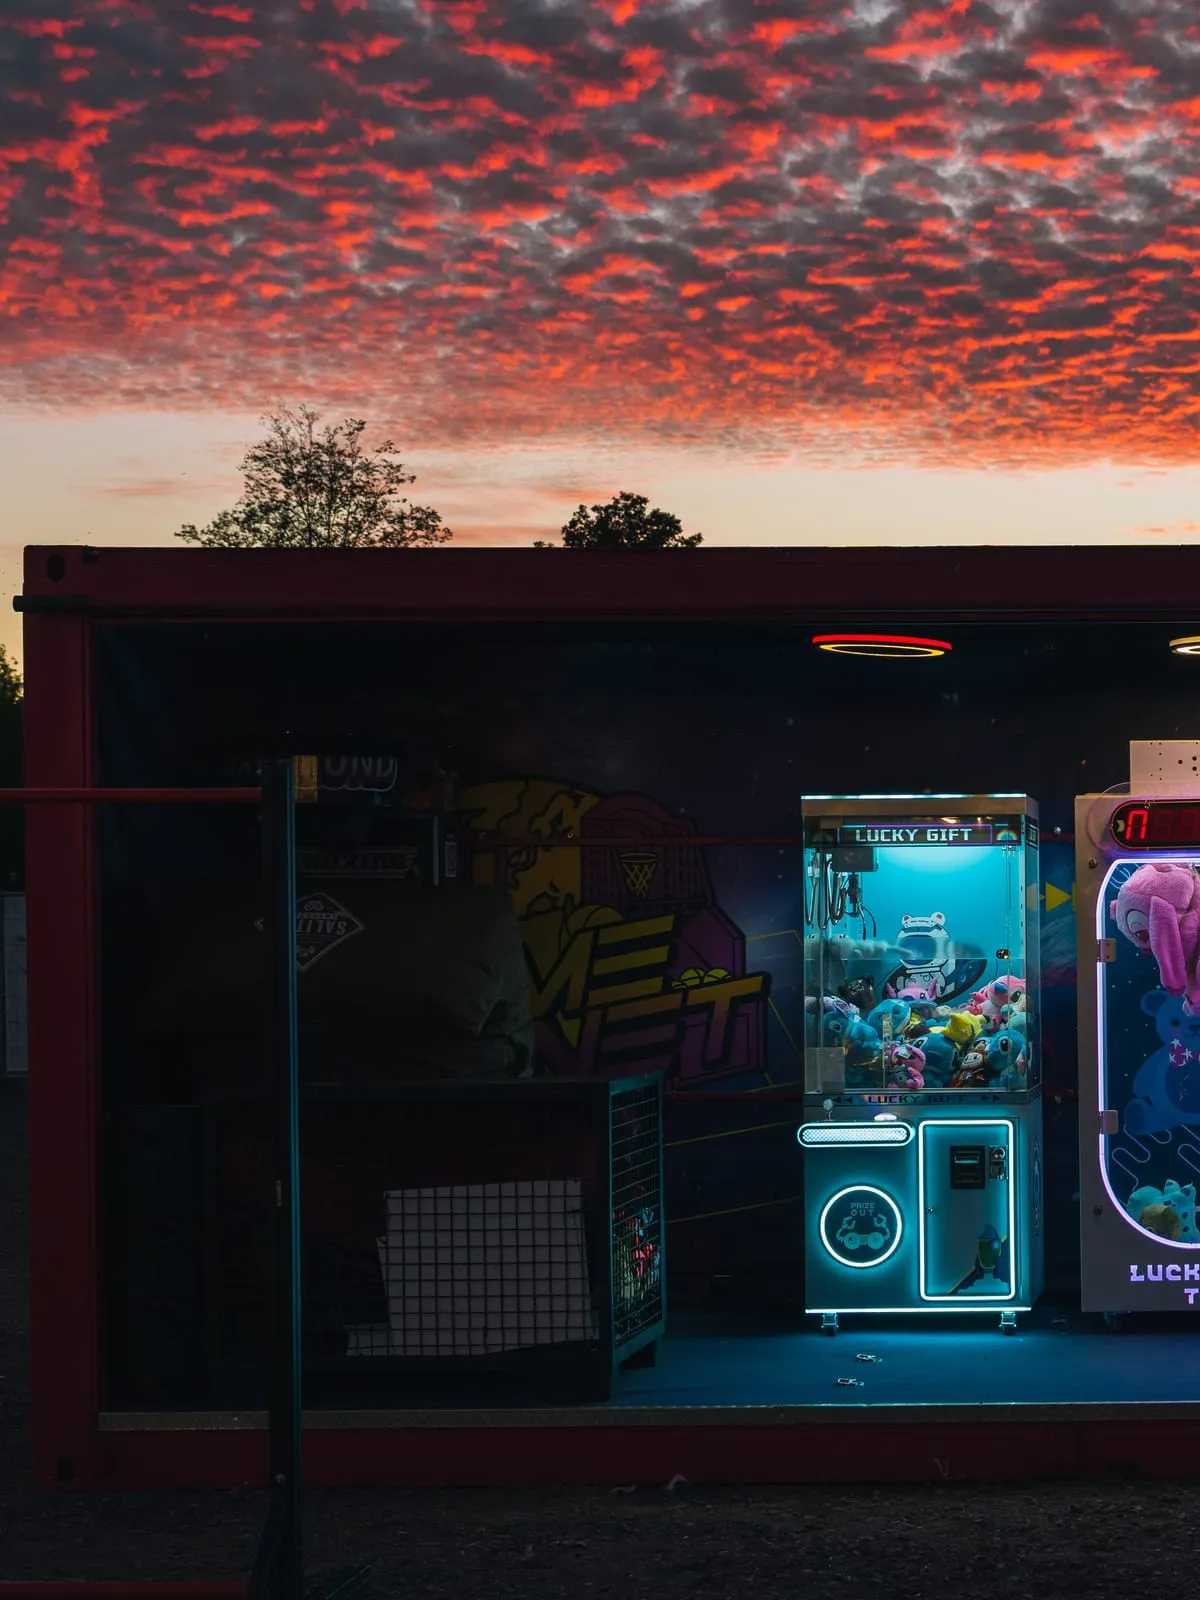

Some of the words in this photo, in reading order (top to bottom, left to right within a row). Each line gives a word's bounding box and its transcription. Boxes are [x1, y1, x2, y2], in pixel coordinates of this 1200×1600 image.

[855, 828, 920, 842] LUCKY
[926, 828, 972, 842] GIFT
[868, 1095, 920, 1104] LUCKY
[926, 1094, 967, 1104] GIFT
